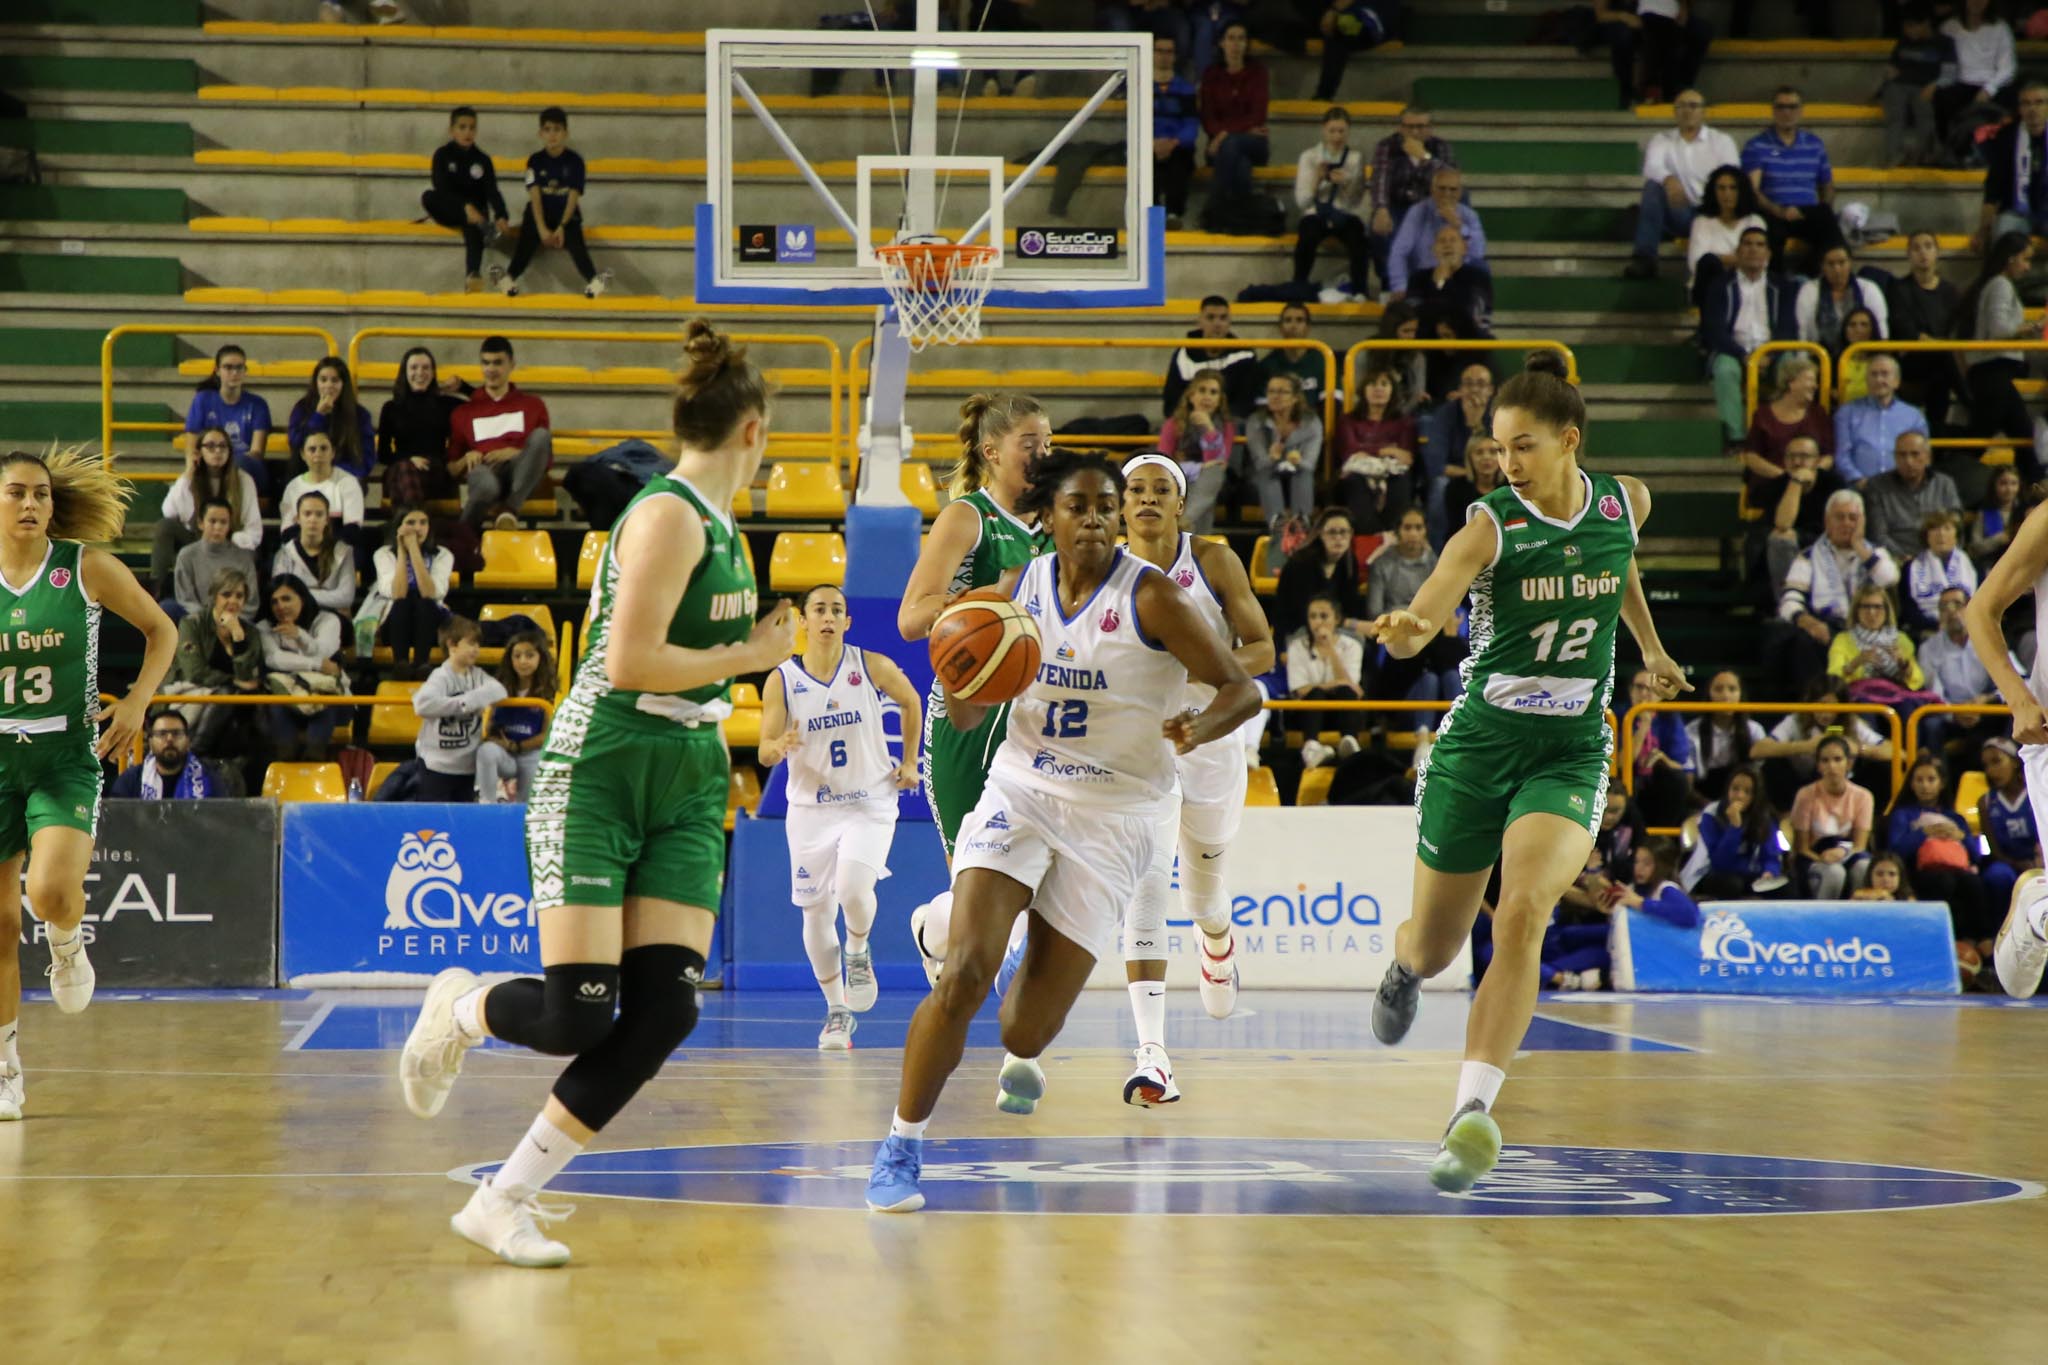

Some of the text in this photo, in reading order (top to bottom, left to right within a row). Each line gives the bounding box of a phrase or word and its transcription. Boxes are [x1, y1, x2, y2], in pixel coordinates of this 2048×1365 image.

[1045, 232, 1115, 245] EuroCup
[1049, 245, 1105, 253] women
[1521, 571, 1620, 601] UNI Győr
[708, 593, 743, 622] UNI
[16, 628, 65, 653] Győr
[1529, 617, 1598, 662] 12
[0, 665, 52, 705] 13
[1035, 663, 1108, 690] VENIDA
[808, 710, 862, 732] AVENIDA
[1042, 700, 1088, 738] 12
[830, 740, 847, 768] 6
[1166, 881, 1381, 926] enida
[1718, 937, 1891, 965] avenida
